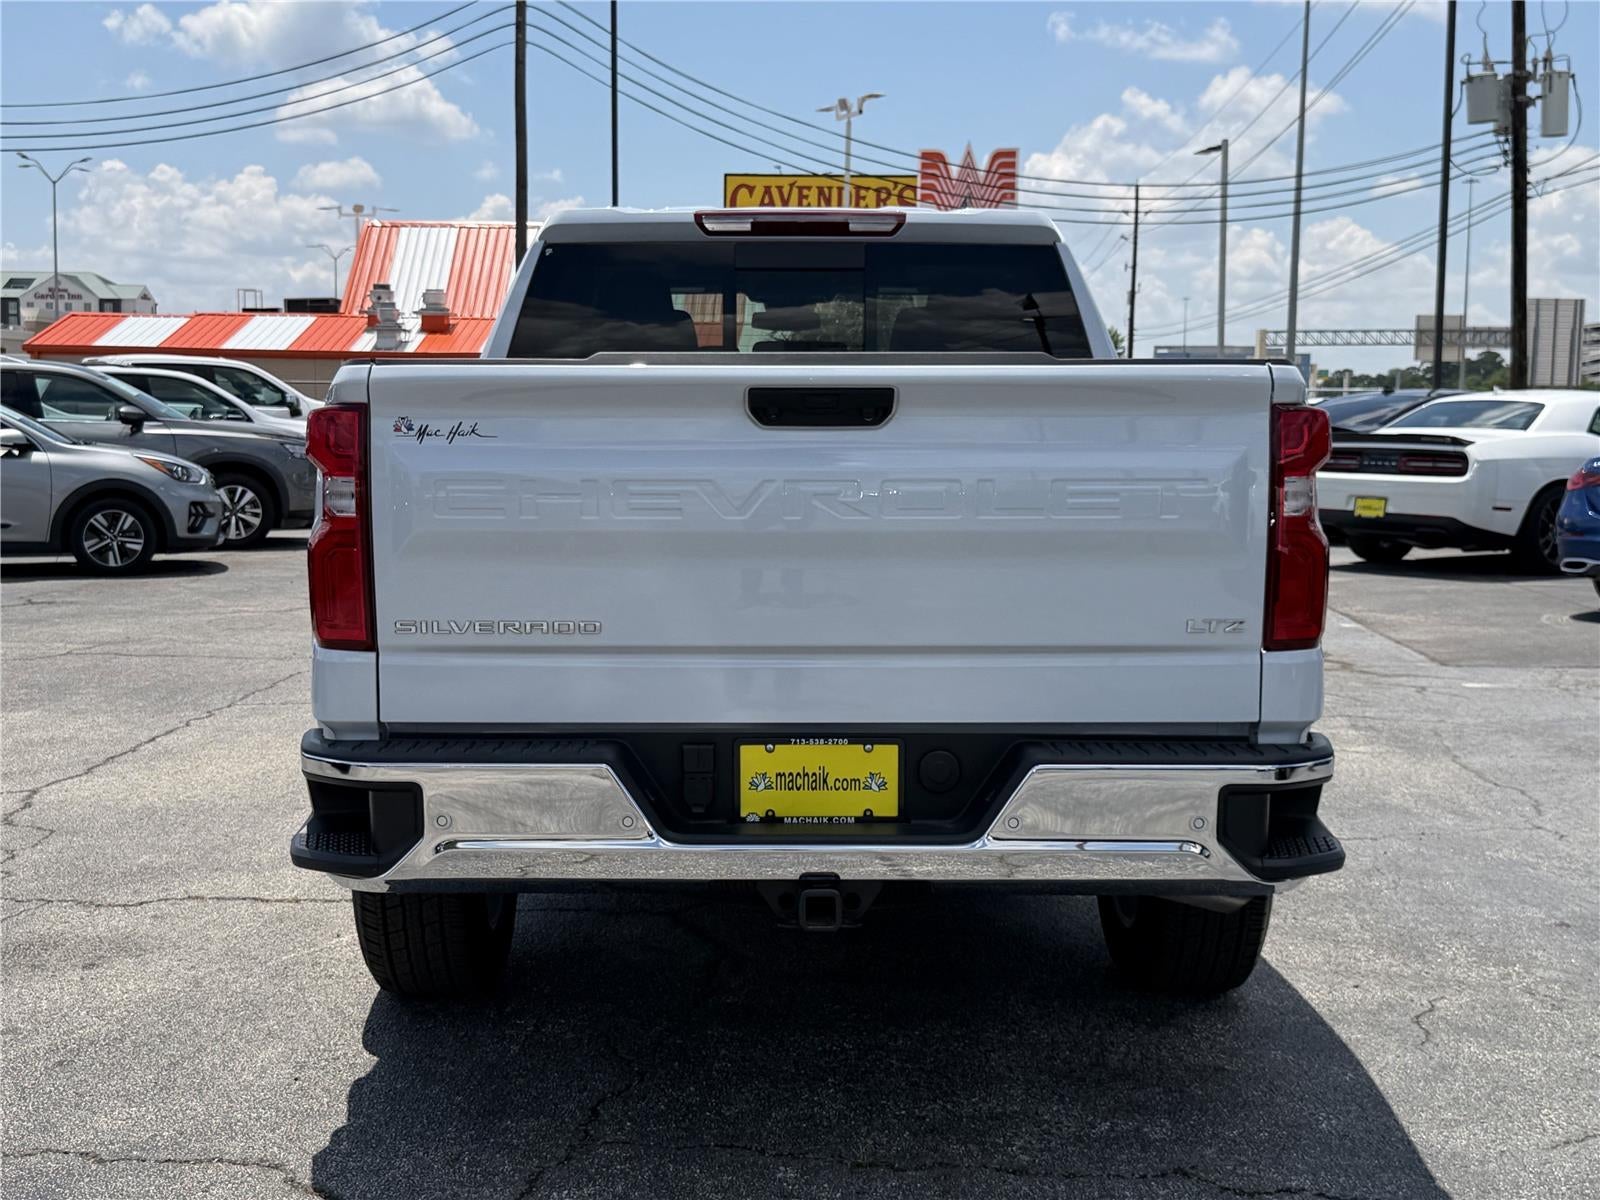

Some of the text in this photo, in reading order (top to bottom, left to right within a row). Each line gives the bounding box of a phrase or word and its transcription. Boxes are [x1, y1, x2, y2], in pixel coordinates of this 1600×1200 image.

[33, 291, 82, 300] Gardn Inn
[413, 421, 498, 445] Mac Haik
[432, 478, 1209, 520] CHEVROLET
[394, 619, 602, 635] SILVERADO
[1186, 618, 1246, 633] LTZ
[775, 766, 862, 792] machaik.com
[784, 816, 856, 825] MACHAIK.COM
